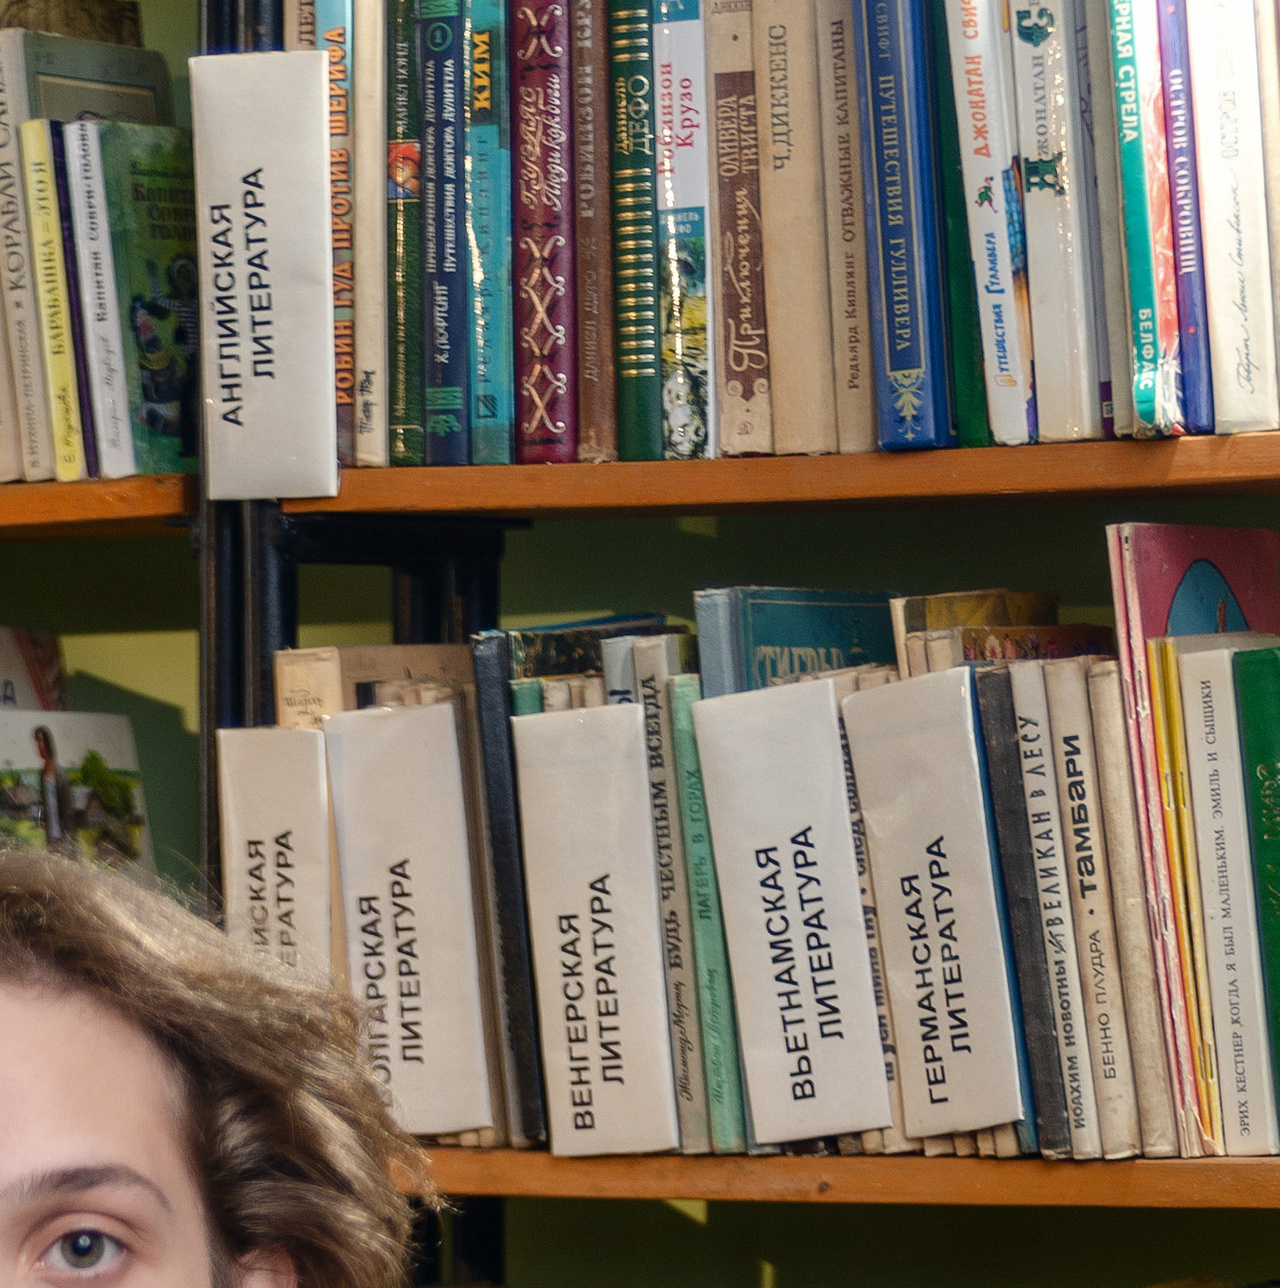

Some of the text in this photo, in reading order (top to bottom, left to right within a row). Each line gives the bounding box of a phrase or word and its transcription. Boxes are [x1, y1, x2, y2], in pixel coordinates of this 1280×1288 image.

[472, 30, 491, 111] КИМ
[627, 74, 654, 156] ДЕФО
[655, 62, 677, 176] Робинзон
[674, 77, 700, 148] Крузо
[718, 95, 741, 179] ОЛИВЕРА
[739, 93, 759, 174] ТВИСТА
[963, 54, 991, 158] ДЖОНАТАН
[1114, 0, 1139, 144] РНАЯ СТРЕЛА
[29, 160, 49, 175] Я
[33, 181, 55, 218] ЭТО
[323, 26, 355, 405] РОБИН ГУД ПРОТИВ ШЕРИФА
[829, 19, 861, 390] Редьярд Киплинг ОТВАЖНЫЕ КАПИТАНЫ
[877, 74, 904, 227] ПУТЕШЕСТВИЯ
[1168, 68, 1197, 275] ОСТРОВ СОКРОВИЩ
[38, 238, 67, 356] БАРАБАШКА
[87, 251, 109, 324] Капитан
[209, 203, 245, 428] АНГЛИЙСКАЯ
[241, 167, 275, 380] ЛИТЕРАТУРА
[887, 236, 911, 352] ГУЛЛИВЕРА
[637, 673, 665, 771] ВСЕГДА
[274, 830, 297, 968] ЕРАТУРА
[649, 780, 676, 902] ЧЕСТНЫМ
[684, 768, 712, 921] ЛАГЕРЬ В ГОРАХ
[1199, 680, 1252, 1136] ЭРИХ КЕСТНЕР КОГДА Я БЫЛ МАЛЕНЬКИМ. ЭМИЛЬ И СЫЩИКИ
[388, 858, 425, 1065] ЛИТЕРАТУРА
[588, 873, 625, 1085] ЛИТЕРАТУРА
[664, 909, 684, 971] БУДЬ
[754, 845, 816, 1100] ВЬЕТНАМСКАЯ
[789, 826, 845, 1040] ЛИТЕРАТУРА
[900, 873, 949, 1106] ГЕРМАНСКАЯ
[924, 835, 972, 1054] ЛИТЕРАТУРА
[1018, 714, 1086, 1130] ИОАХИМ НОВОТНЫ ВЕЛИКАН В ЛЕСУ
[1088, 929, 1108, 1005] ПЛУДРА
[557, 913, 596, 1130] ВЕНГЕРСКАЯ
[1096, 1012, 1117, 1080] БЕННО
